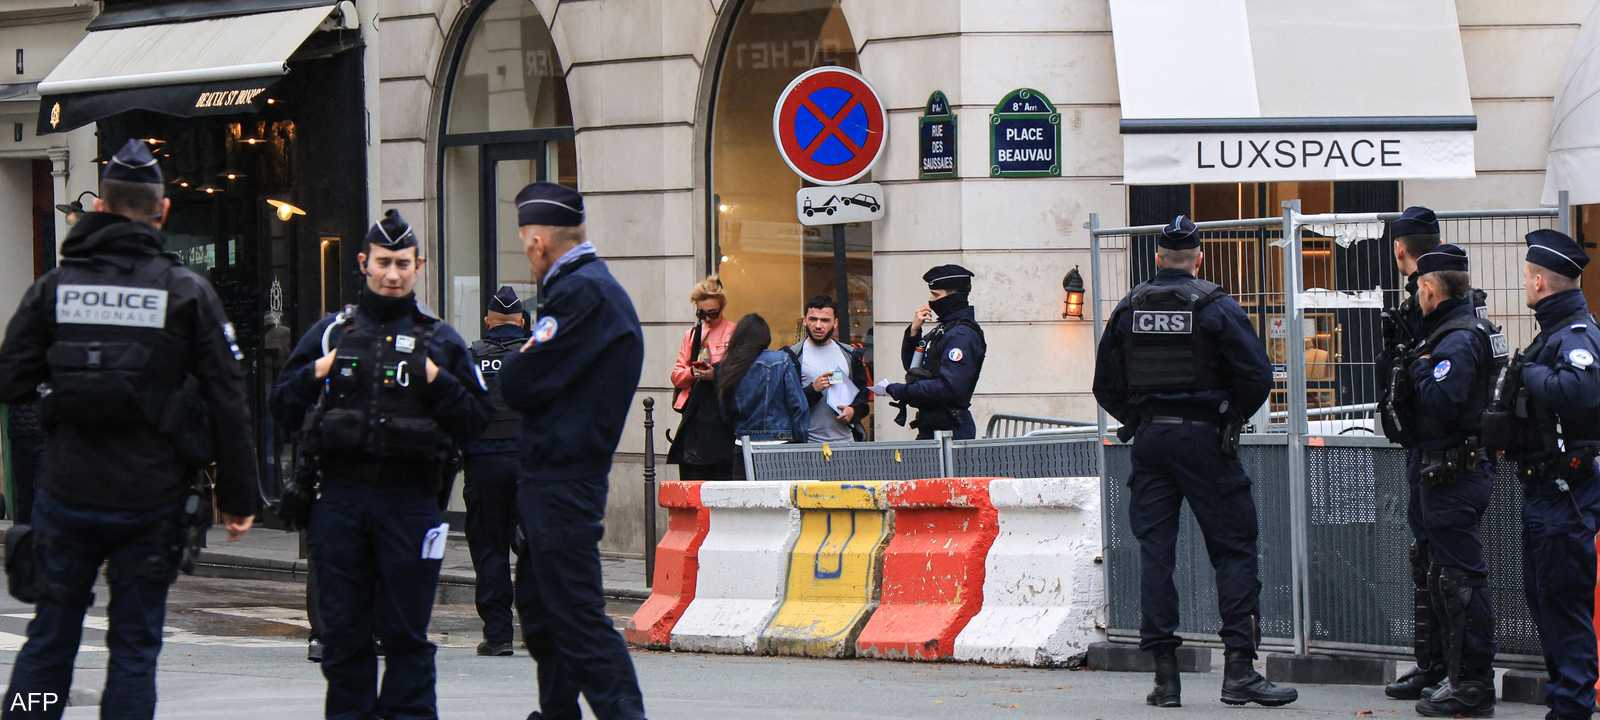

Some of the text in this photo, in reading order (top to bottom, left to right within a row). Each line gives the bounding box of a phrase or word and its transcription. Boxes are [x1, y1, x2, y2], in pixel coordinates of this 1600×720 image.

[931, 125, 944, 137] RUE
[1006, 128, 1044, 141] PLACE
[931, 141, 944, 153] DES
[1197, 139, 1402, 168] LUXSPACE
[998, 149, 1052, 162] BEAUVAU
[923, 156, 953, 170] SAUSSAIES
[63, 290, 159, 310] POLICE
[61, 310, 160, 323] NATIONALE
[1139, 314, 1185, 331] CRS
[481, 359, 502, 371] PO
